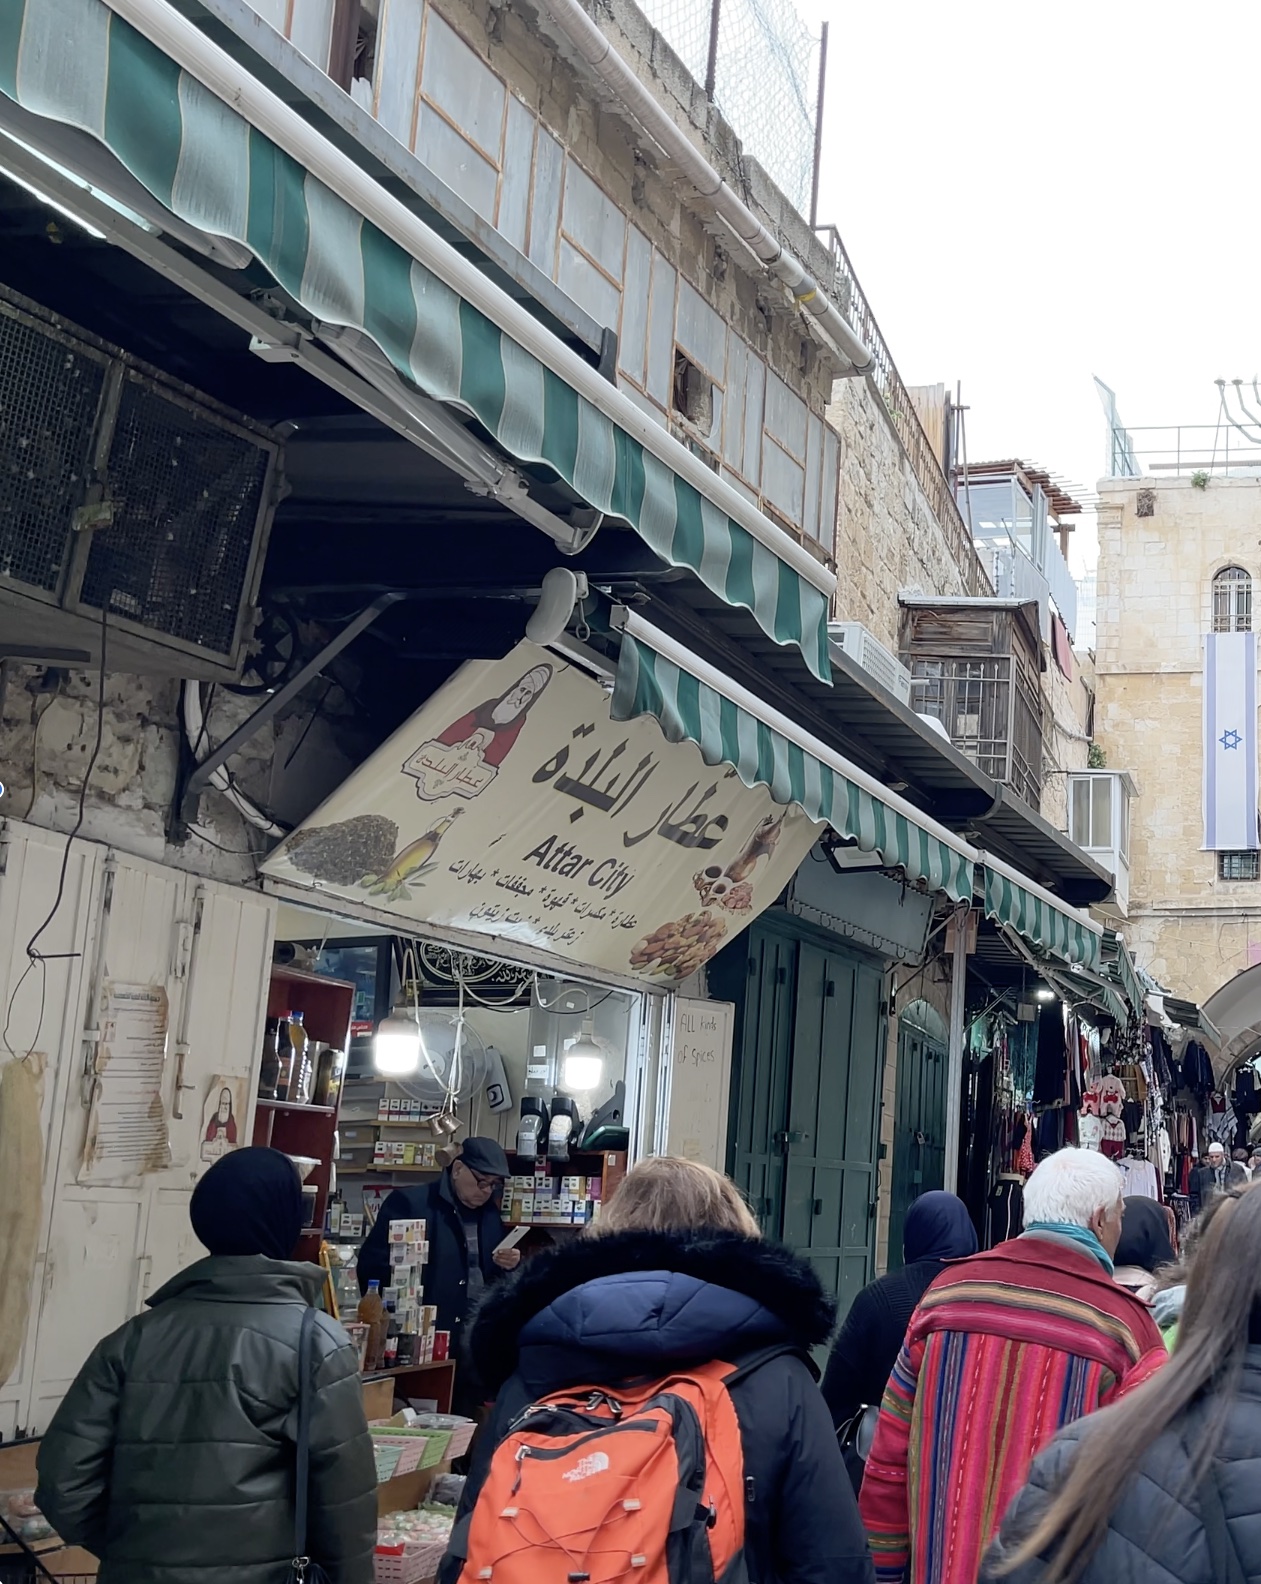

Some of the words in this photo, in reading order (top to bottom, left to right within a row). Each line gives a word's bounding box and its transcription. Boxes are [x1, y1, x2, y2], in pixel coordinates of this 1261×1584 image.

[532, 722, 660, 824] البلدة
[449, 860, 486, 884] بهارات
[522, 834, 594, 879] Attar
[588, 858, 635, 900] City
[495, 874, 534, 898] مجففات
[542, 888, 573, 911] قهوة
[574, 901, 606, 919] مكسرات
[610, 911, 637, 930] عطارة
